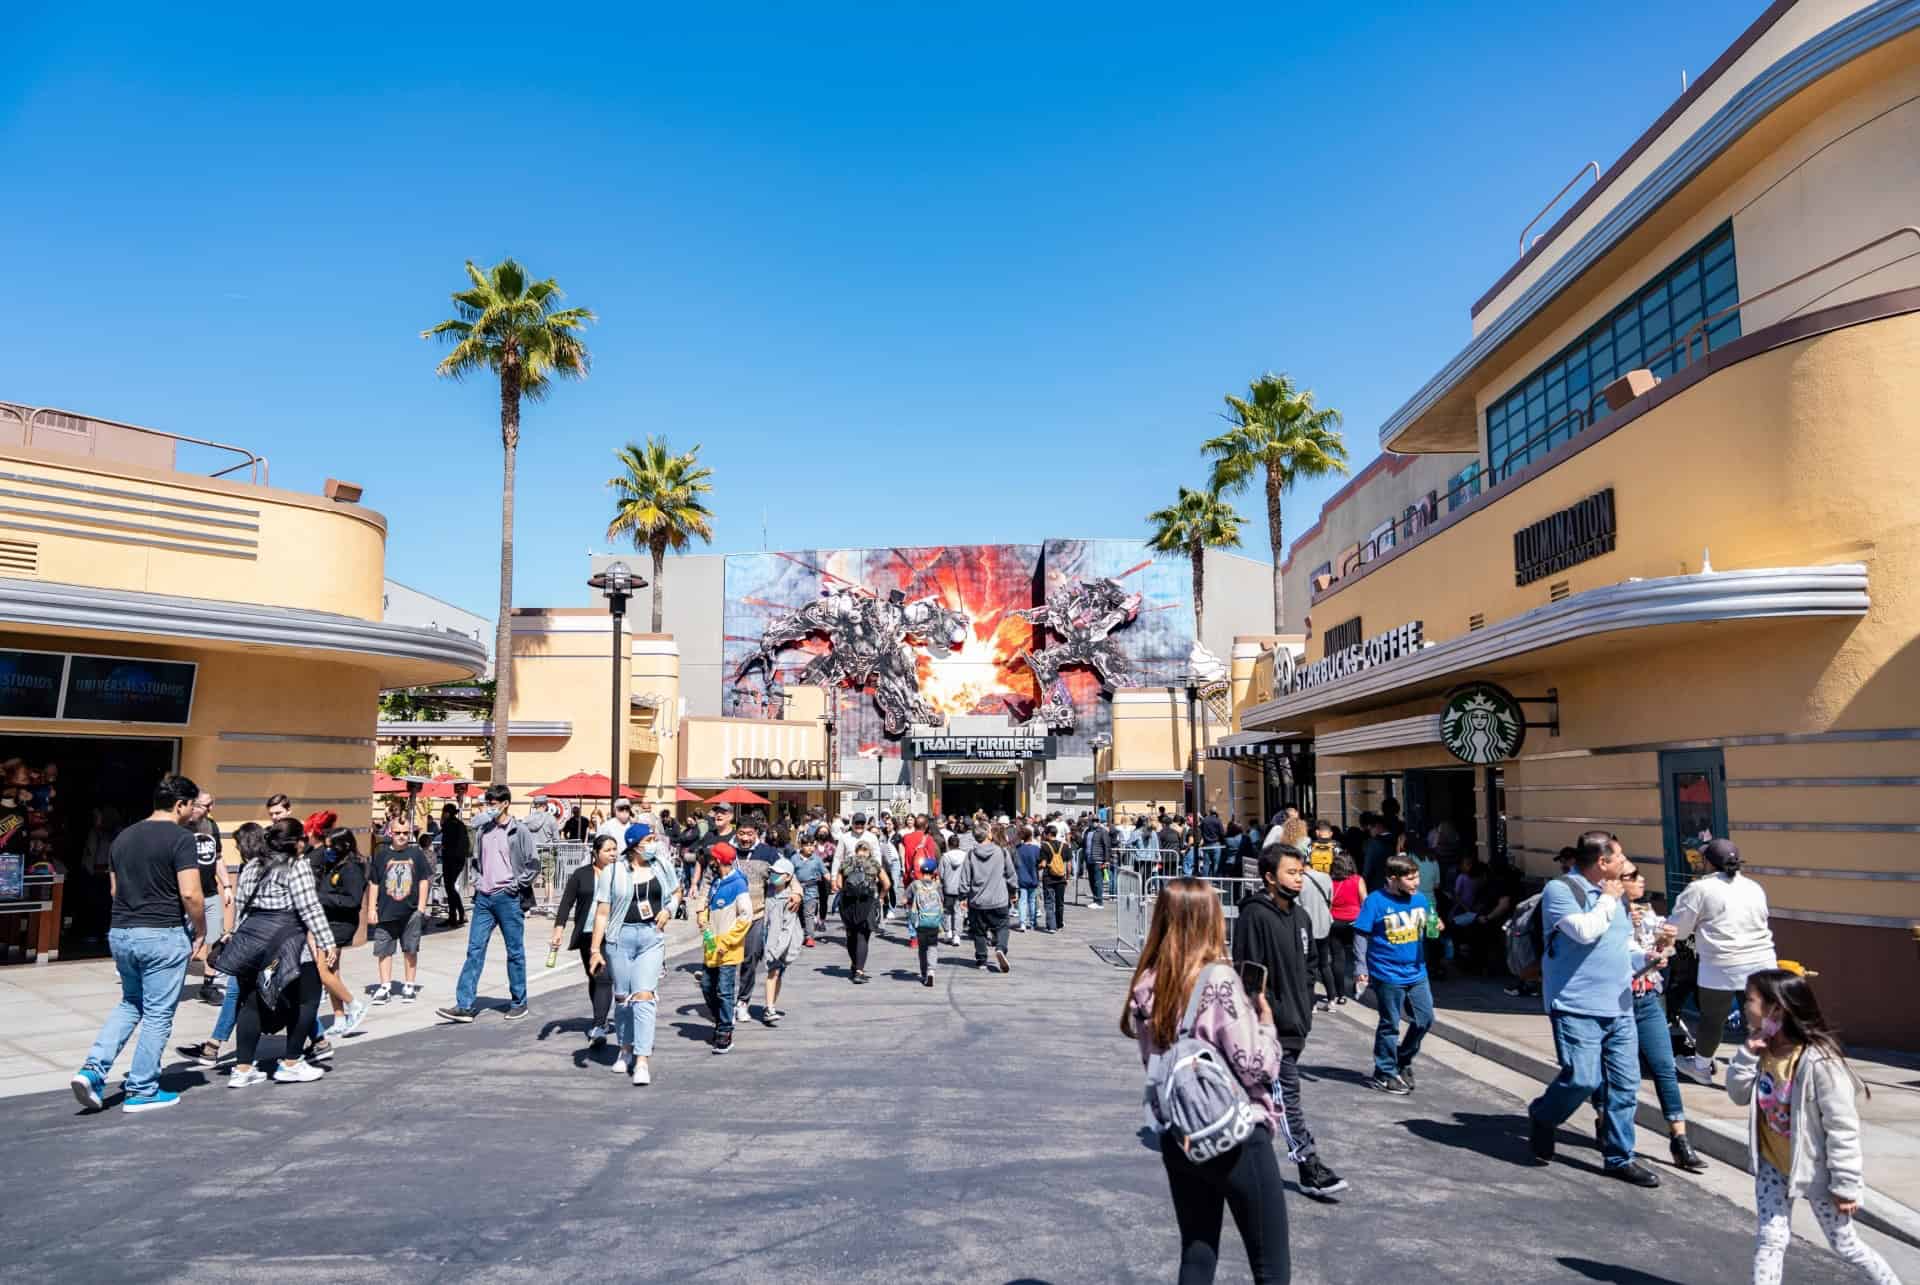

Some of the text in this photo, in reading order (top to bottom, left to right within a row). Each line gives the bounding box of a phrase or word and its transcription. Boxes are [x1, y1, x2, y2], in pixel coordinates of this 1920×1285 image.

[1514, 488, 1616, 570] ILLUMINATION
[1296, 643, 1363, 690] STARBUCKS
[1363, 620, 1424, 669] COFFEE
[912, 738, 1045, 758] TRANSFORMERS
[977, 750, 994, 758] THE
[730, 757, 784, 780] STUDIO
